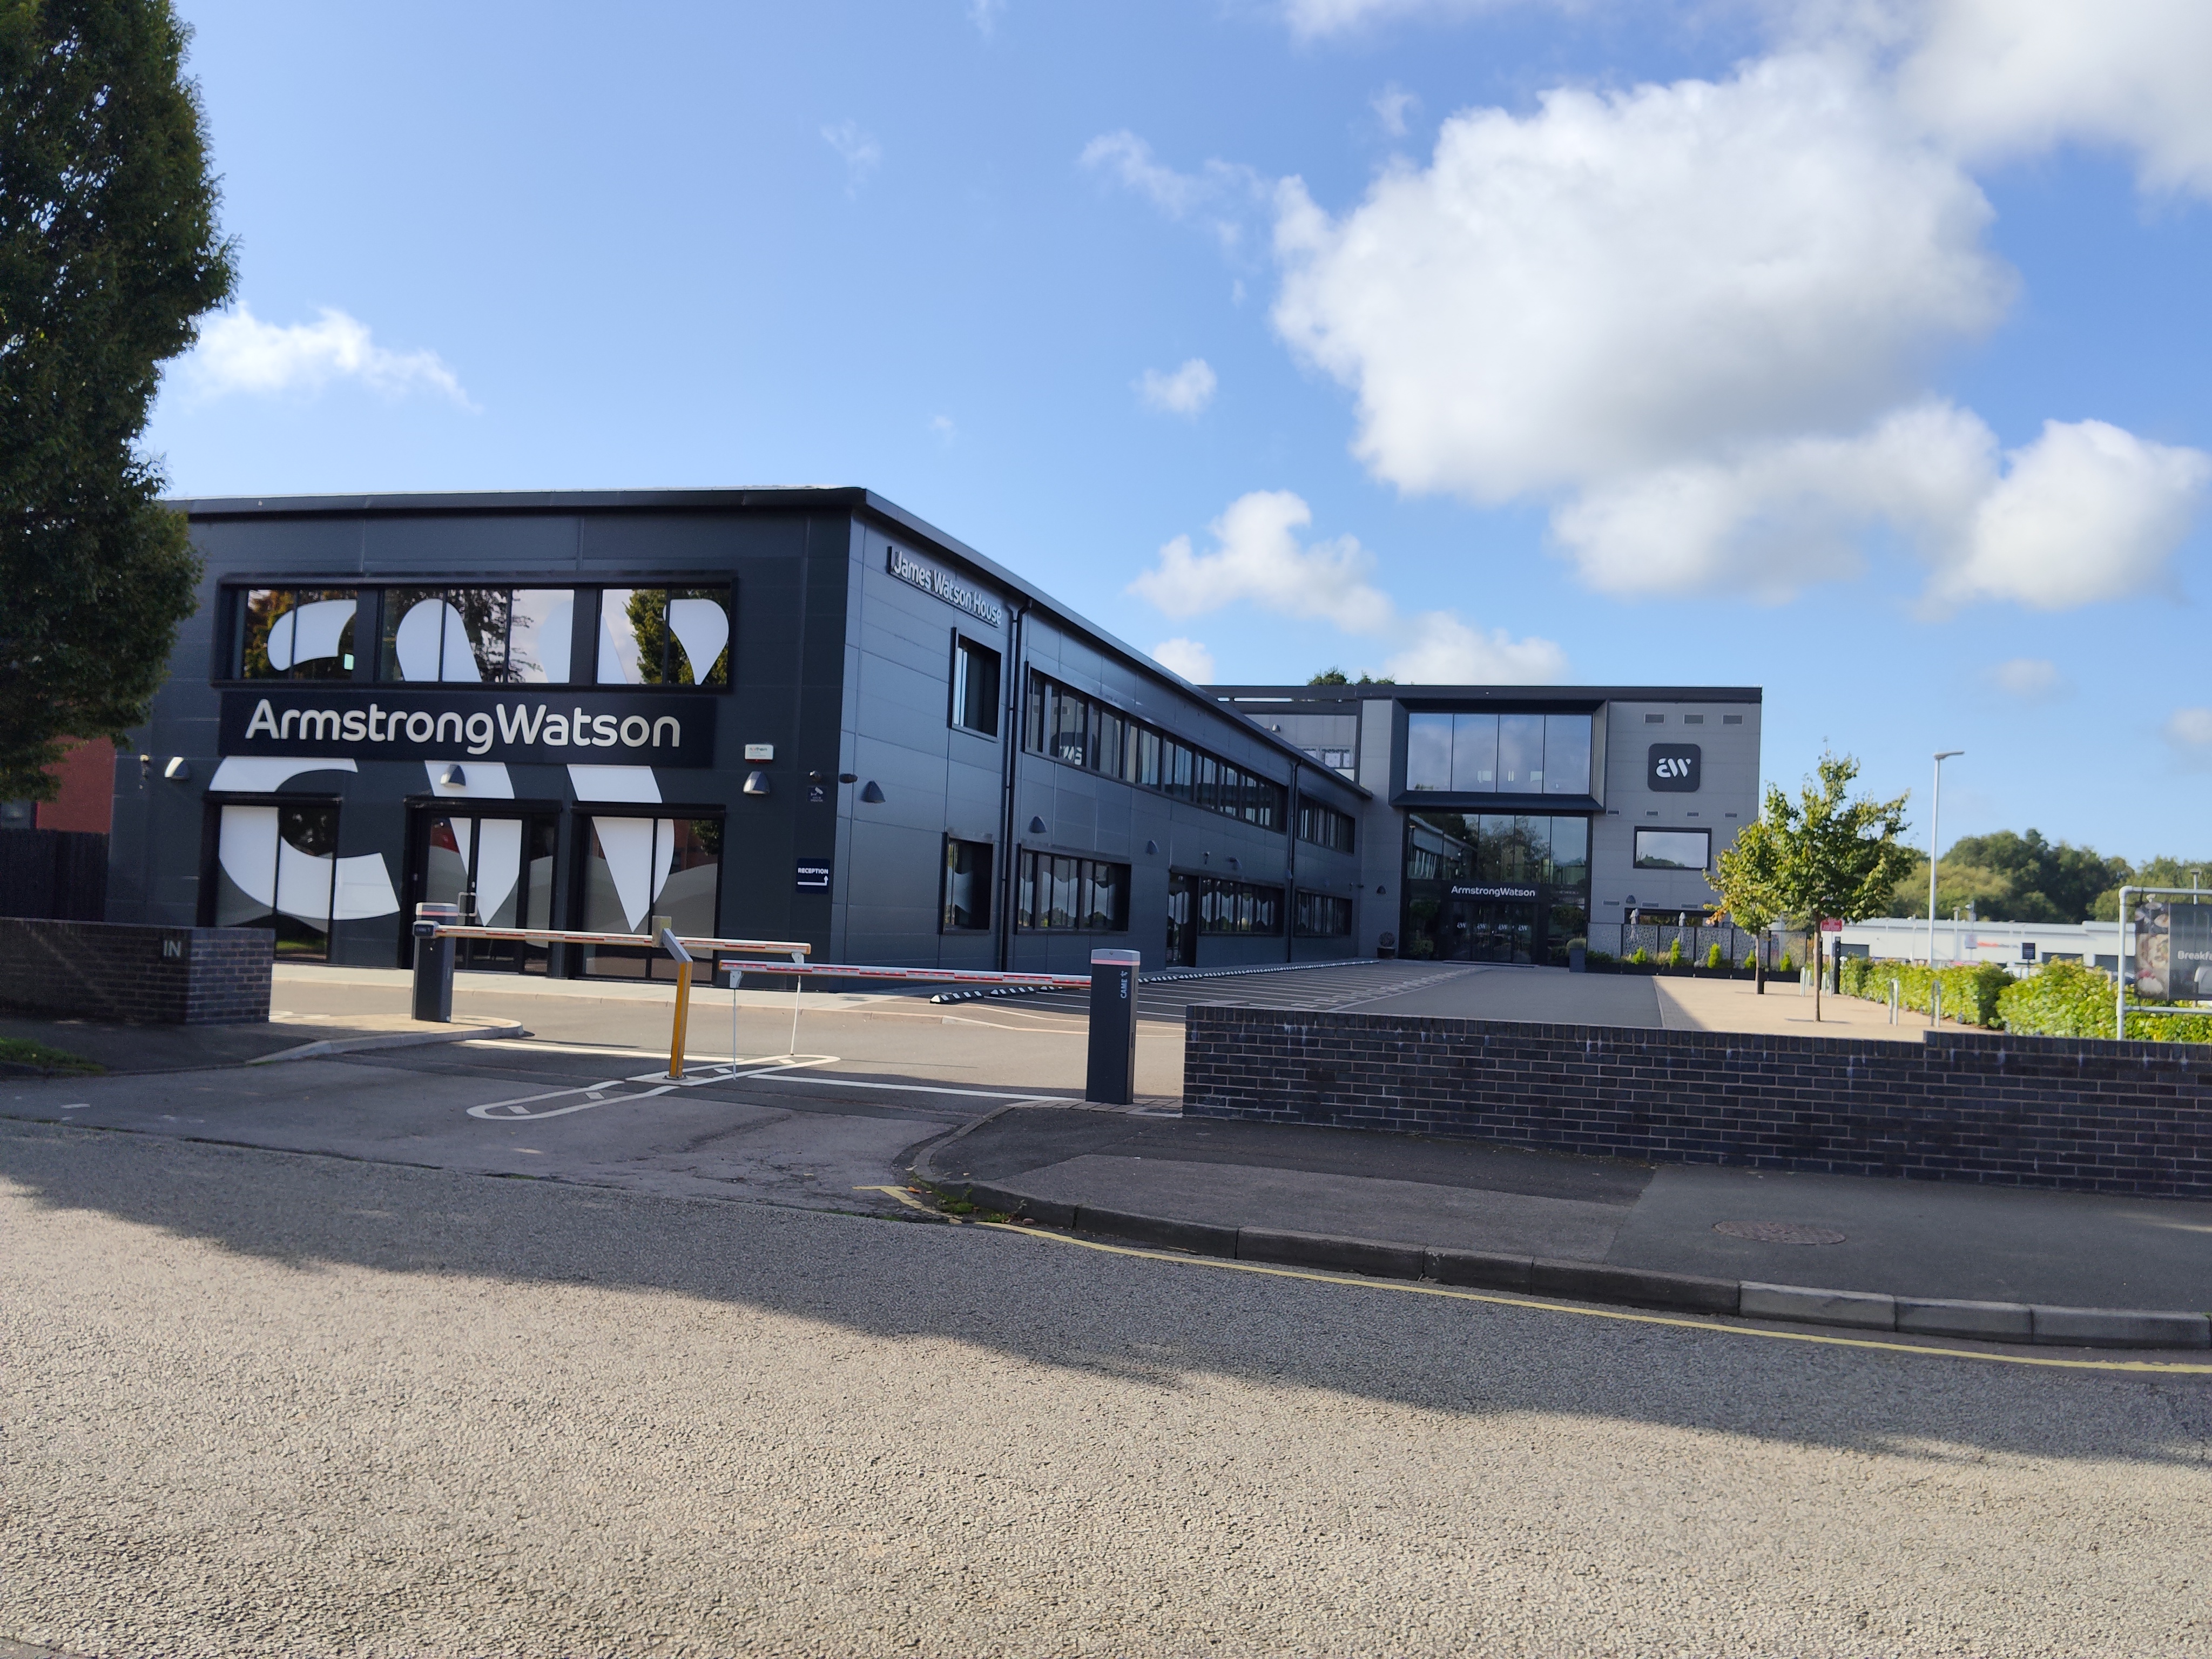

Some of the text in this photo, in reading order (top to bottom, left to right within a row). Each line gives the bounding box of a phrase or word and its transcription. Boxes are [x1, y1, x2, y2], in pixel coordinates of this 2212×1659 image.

[894, 551, 1002, 625] James Watson House
[245, 699, 680, 754] ArmstrongWatson
[1451, 886, 1535, 897] ArmstrongWatson
[164, 940, 181, 956] IN
